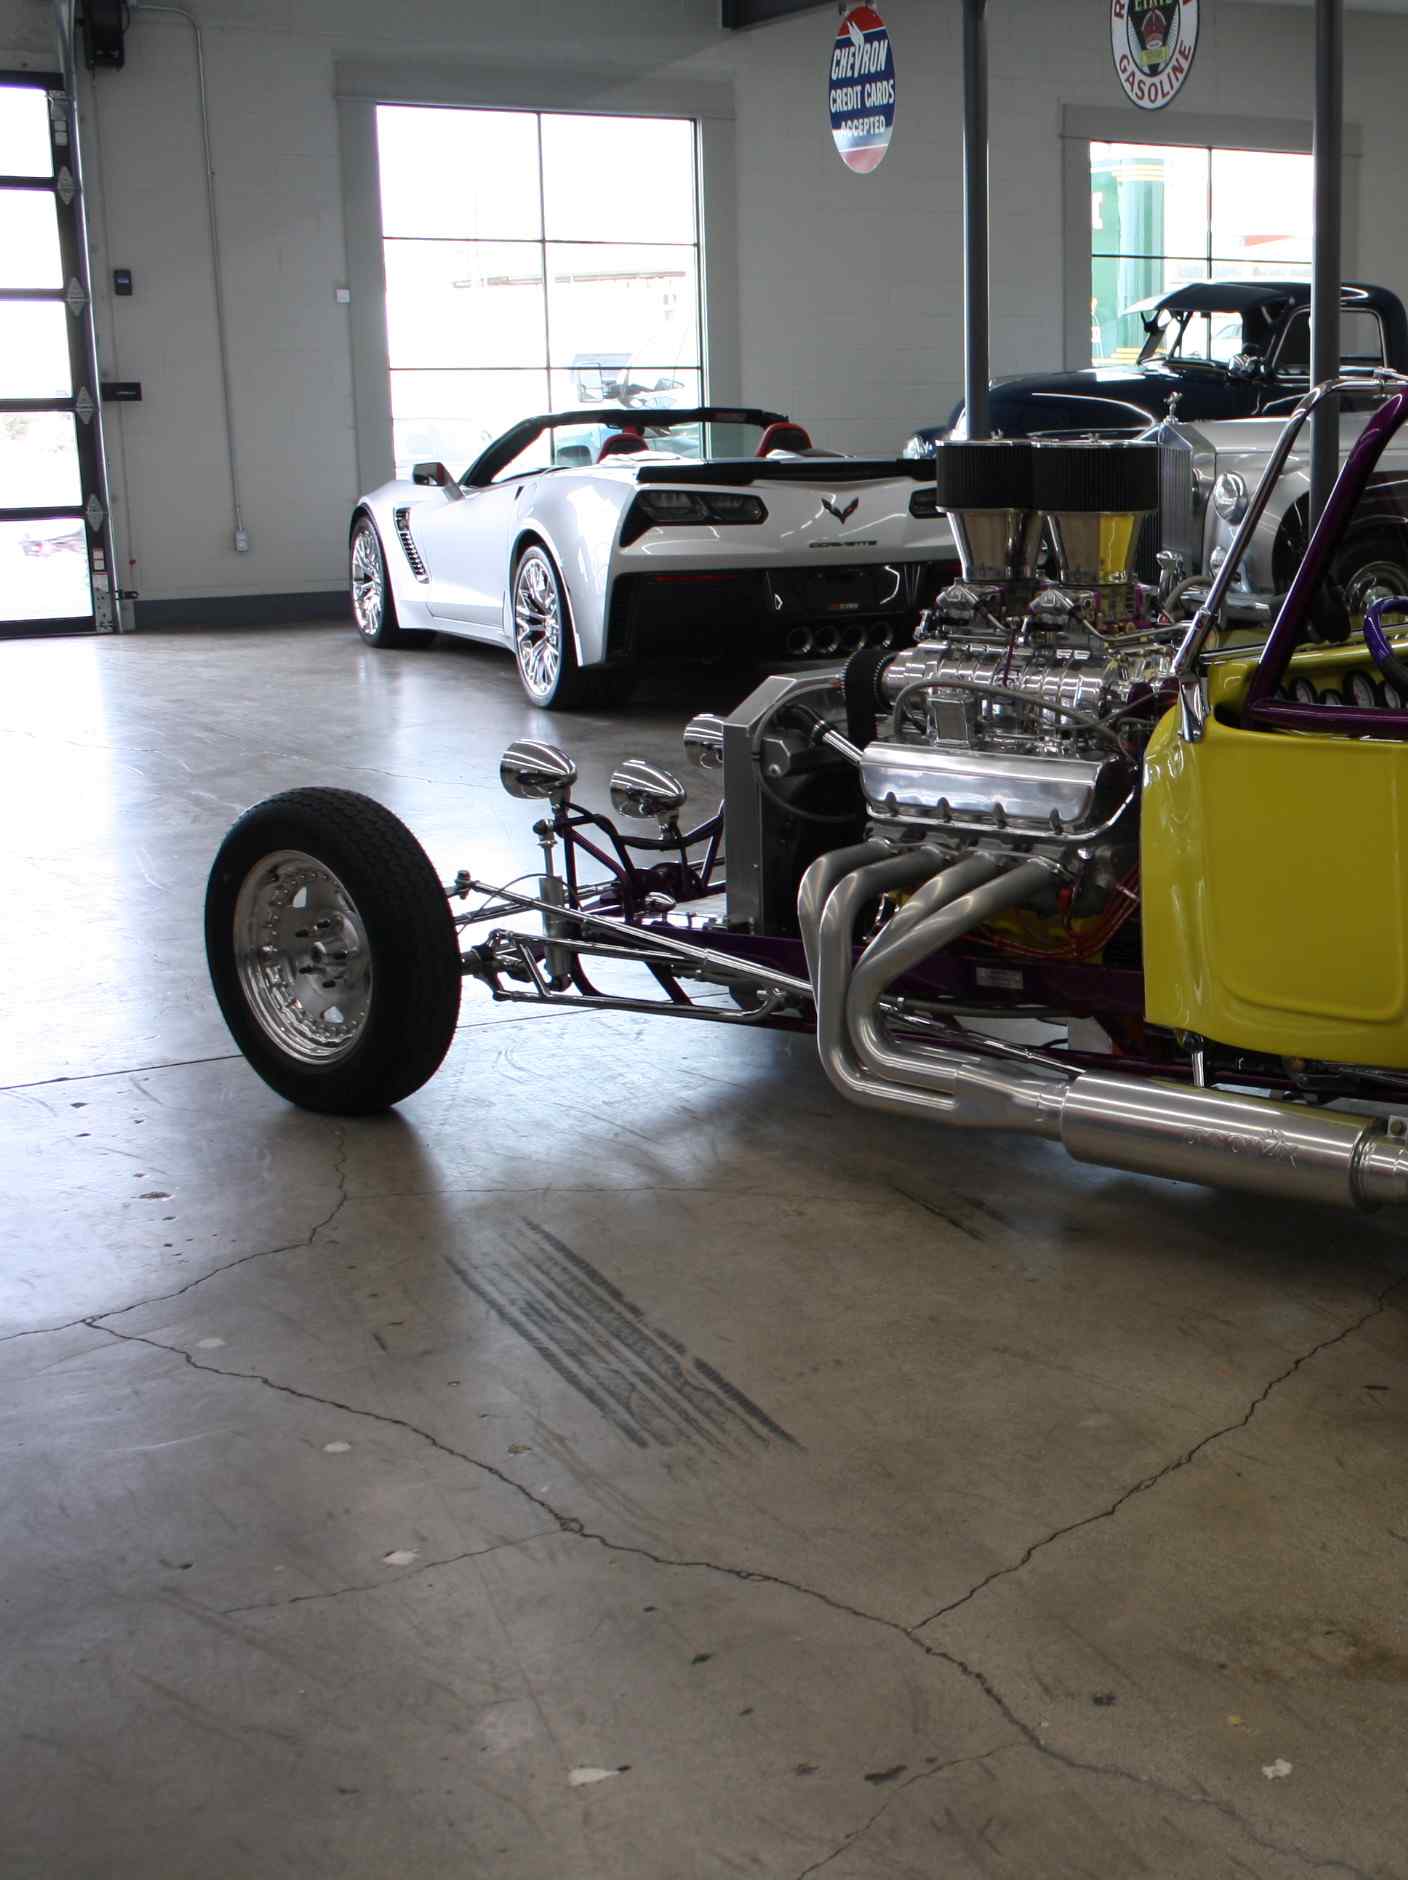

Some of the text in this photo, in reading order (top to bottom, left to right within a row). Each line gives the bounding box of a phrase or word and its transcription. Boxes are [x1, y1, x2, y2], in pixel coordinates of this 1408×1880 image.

[831, 38, 888, 80] CHEVRON
[1119, 40, 1192, 103] GASOLINE
[830, 79, 895, 113] CREDIT CARDS
[840, 115, 886, 137] ACCEPTED
